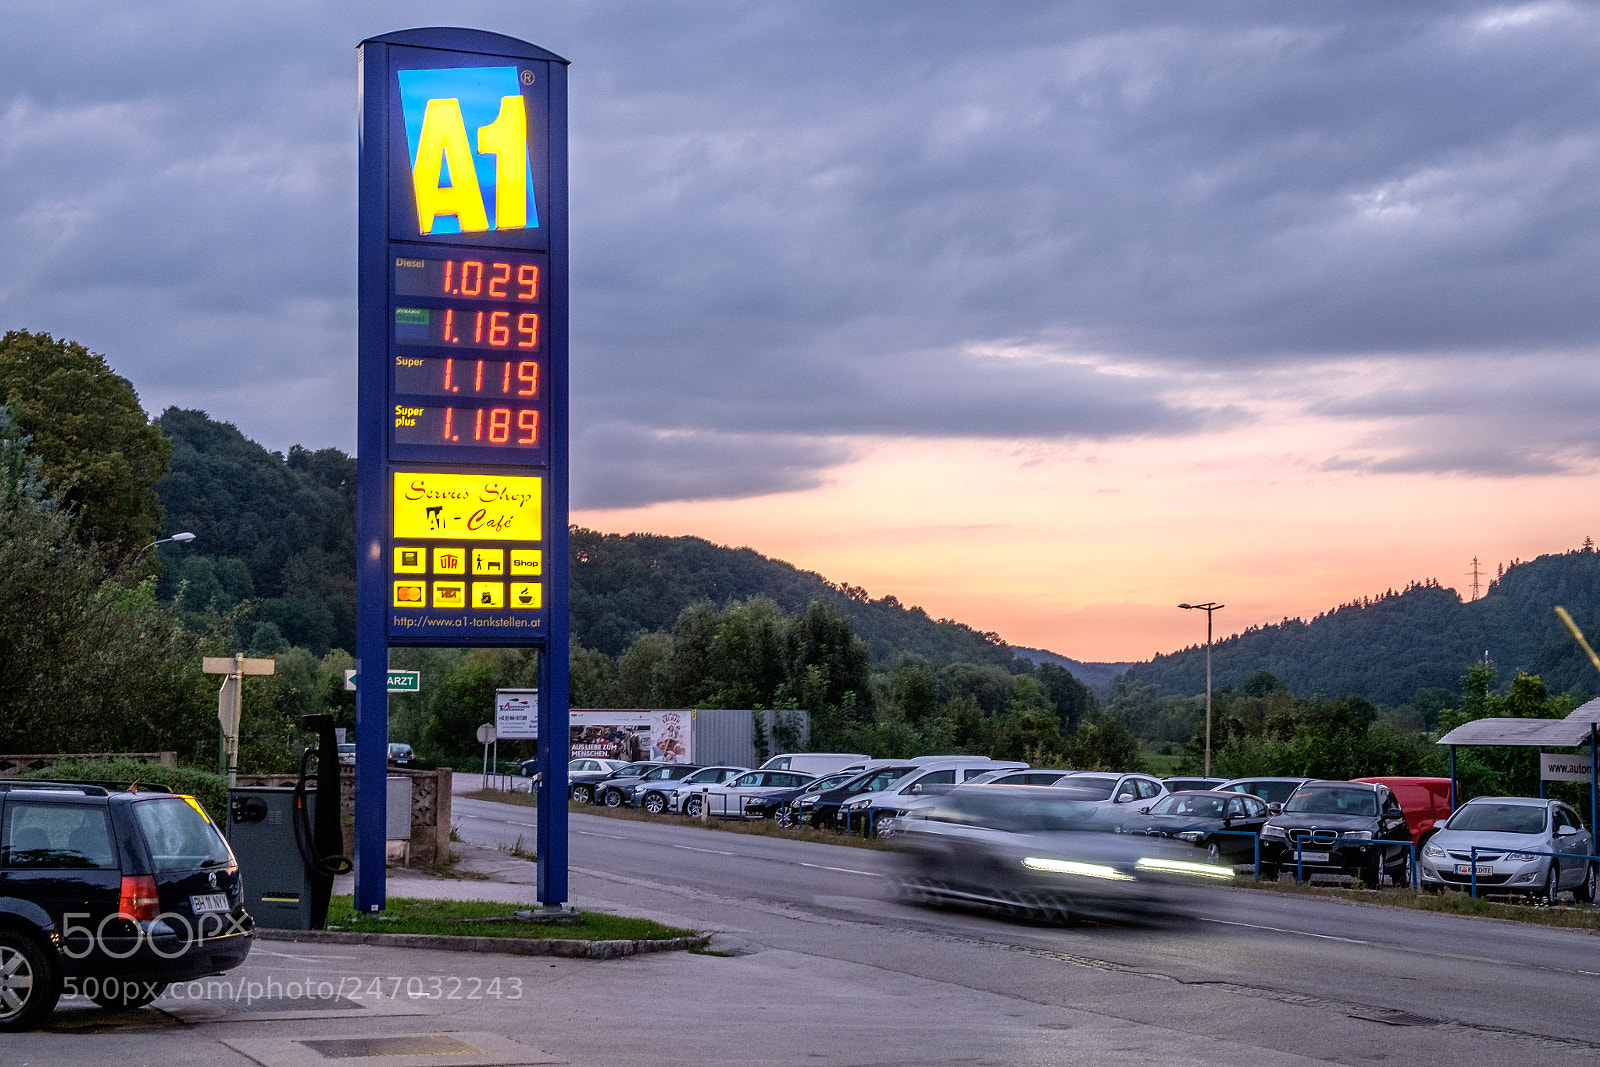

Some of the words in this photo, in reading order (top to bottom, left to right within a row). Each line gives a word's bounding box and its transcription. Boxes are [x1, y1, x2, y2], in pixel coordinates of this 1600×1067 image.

[413, 95, 527, 235] A1
[396, 257, 425, 268] Diesel
[444, 260, 539, 300] 1.029
[397, 313, 425, 322] Diesel
[444, 308, 539, 347] 1.169
[396, 356, 424, 367] Super
[444, 358, 539, 397] 1.119
[395, 405, 424, 417] Super
[395, 416, 416, 428] plus
[444, 407, 539, 445] 1.189
[405, 480, 469, 501] Servus
[479, 483, 532, 507] Shop
[467, 508, 514, 532] Café
[440, 554, 458, 569] UTA
[393, 615, 541, 629] http://www.a1-tankstellen.at
